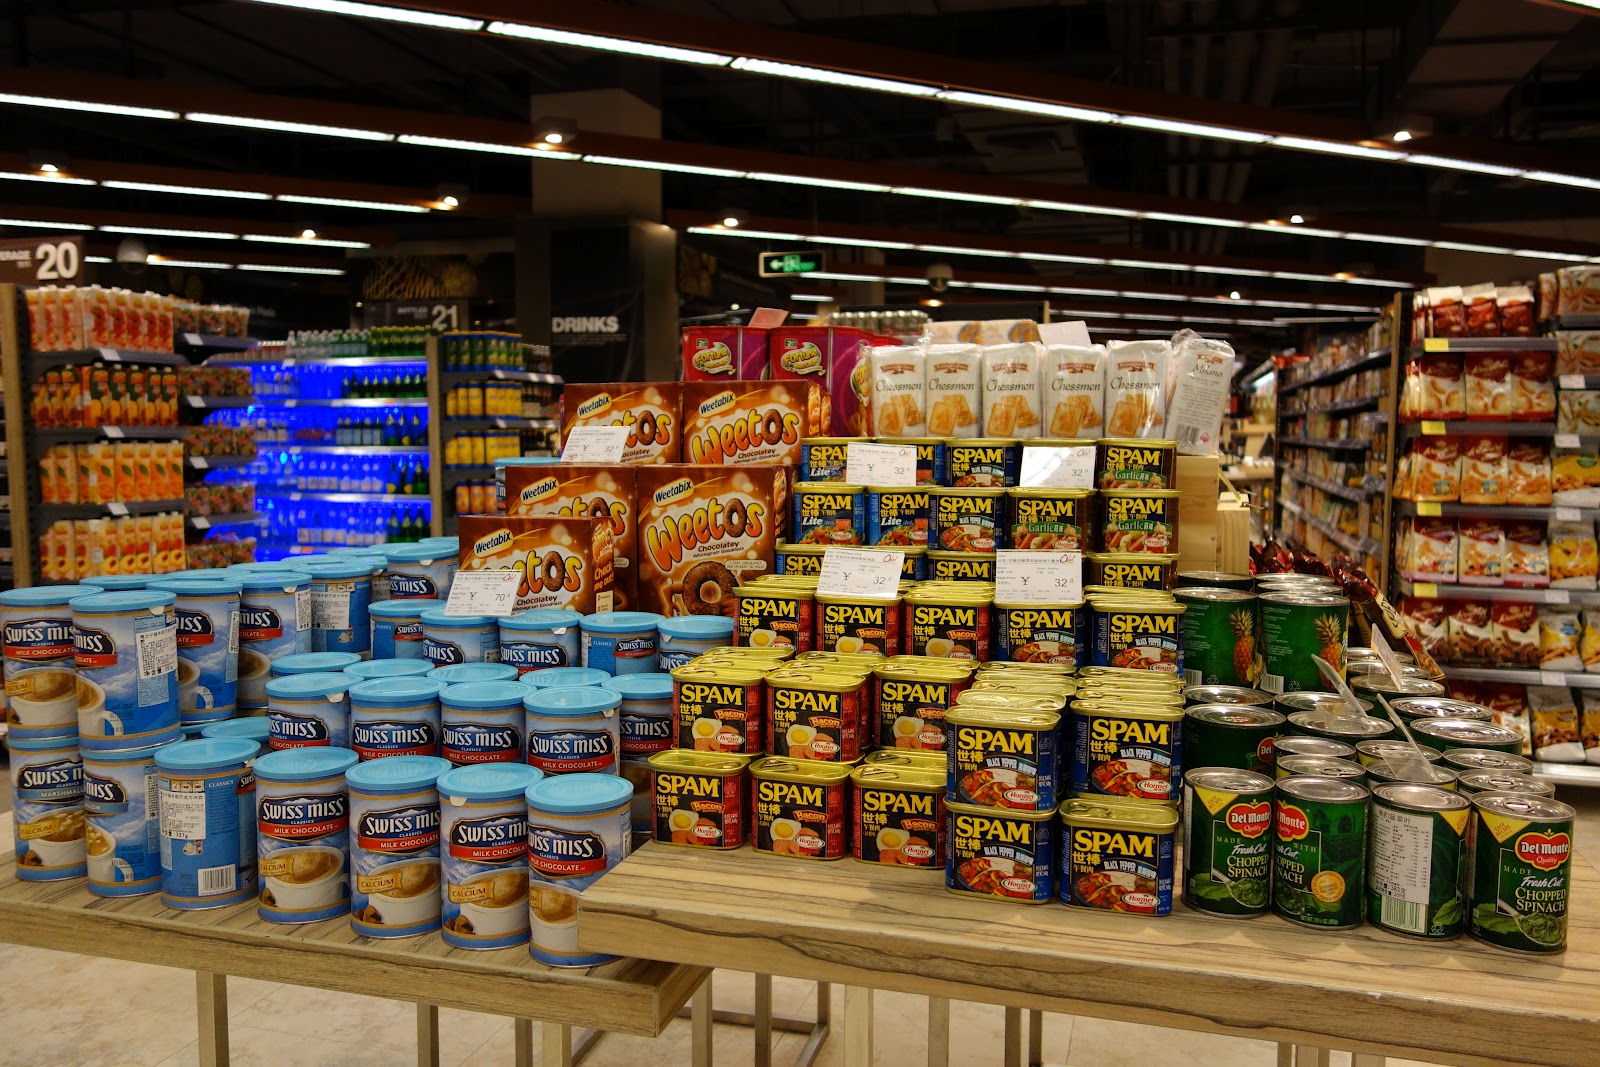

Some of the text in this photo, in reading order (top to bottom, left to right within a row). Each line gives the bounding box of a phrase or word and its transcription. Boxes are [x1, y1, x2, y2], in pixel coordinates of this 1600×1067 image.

[35, 241, 79, 280] 20
[432, 305, 458, 329] 21
[552, 316, 620, 333] DRINKS
[875, 379, 922, 391] Chessmen
[928, 378, 975, 391] Chessmen
[986, 379, 1035, 392] Chessmen
[1051, 378, 1101, 391] Chessmen
[1110, 376, 1161, 390] Chessmen
[578, 394, 612, 416] Weetabix
[700, 393, 735, 415] Weetabix
[738, 448, 769, 460] Chocolatey
[953, 448, 1004, 463] SPAM
[1107, 448, 1161, 466] SPAM
[894, 466, 905, 475] 32
[1071, 468, 1083, 477] 32
[1115, 470, 1140, 481] Garlic
[522, 478, 558, 501] Weetabix
[655, 479, 693, 503] Weetabix
[802, 493, 852, 510] SPAM
[881, 494, 929, 510] SPAM
[939, 496, 993, 514] SPAM
[1018, 499, 1073, 517] SPAM
[1108, 497, 1163, 515] SPAM
[802, 516, 823, 526] Lite
[880, 516, 902, 526] Lite
[1028, 522, 1054, 532] Garlic
[1118, 520, 1144, 531] Garlic
[475, 531, 511, 553] Weetabix
[697, 540, 740, 554] Chocolatey
[721, 545, 745, 556] Goodness
[936, 560, 990, 578] SPAM
[1103, 564, 1162, 581] SPAM
[400, 580, 428, 594] MISS
[873, 576, 886, 585] 32
[1054, 578, 1068, 588] 32
[495, 593, 506, 602] 70
[516, 593, 558, 606] Chocolatey
[740, 598, 797, 618] SPAM
[825, 605, 884, 625] SPAM
[914, 607, 976, 627] SPAM
[1009, 611, 1073, 629] SPAM
[1111, 615, 1176, 634] SPAM
[5, 627, 43, 644] SWISS
[859, 629, 886, 638] Bacon
[619, 639, 654, 651] SWISS MISS
[429, 646, 456, 664] MISS
[501, 646, 561, 665] SWISS MISS
[680, 683, 743, 706] SPAM
[882, 682, 946, 705] SPAM
[775, 689, 839, 713] SPAM
[881, 702, 904, 714] 世棒
[679, 703, 702, 715] 世棒
[717, 709, 745, 719] Bacon
[774, 709, 797, 722] 世棒
[635, 720, 671, 737] MISS
[812, 716, 840, 728] Bacon
[282, 720, 318, 739] MISS
[354, 726, 428, 745] SWISS MISS
[1091, 719, 1169, 745] SPAM
[442, 728, 513, 748] SWISS MISS
[532, 735, 608, 754] SWISS MISS
[958, 728, 1034, 755] SPAM
[1090, 740, 1117, 754] 世棒
[1120, 748, 1135, 758] BLACK
[957, 750, 984, 764] 世棒
[986, 757, 1001, 768] BLACK
[542, 760, 598, 769] MILK CHOCOLATE
[23, 769, 68, 787] SWISS
[208, 780, 234, 788] CLASSICS
[656, 774, 720, 798] SPAM
[656, 794, 679, 807] 世棒
[759, 781, 824, 808] SPAM
[263, 798, 345, 820] SWISS MISS
[693, 802, 722, 812] Bacon
[758, 802, 781, 815] 世棒
[864, 790, 934, 816] SPAM
[365, 809, 441, 836] SWISS MIS
[796, 811, 825, 822] Bacon
[862, 811, 887, 825] 世棒
[1231, 812, 1270, 824] Del Monte
[1279, 814, 1306, 830] Monte
[273, 824, 334, 835] MILK CHOCOLATE
[905, 819, 936, 830] Bacon
[955, 815, 1031, 845] SPAM
[457, 824, 505, 844] SWISS
[380, 834, 439, 849] MILK CHOCOLATE
[553, 837, 594, 859] MISS
[955, 837, 982, 851] 世棒
[1074, 829, 1154, 858] SPAM
[1520, 841, 1569, 854] Del Monte
[472, 849, 491, 857] MILK
[983, 846, 998, 856] BLACK
[540, 859, 580, 871] CHOCOLATE
[1072, 851, 1100, 866] 世棒
[1103, 860, 1119, 870] BLACK
[1226, 854, 1269, 867] CHOPPED
[1276, 857, 1305, 874] OPPED
[1536, 855, 1558, 865] Quality
[1227, 866, 1268, 879] SPINACH
[1503, 864, 1532, 876] MADE
[360, 878, 395, 889] CALCIUM
[1520, 876, 1547, 889] Fresh
[452, 887, 487, 897] CALCIUM
[1514, 886, 1567, 901] CHOPPED
[1516, 899, 1566, 914] SPINACH
